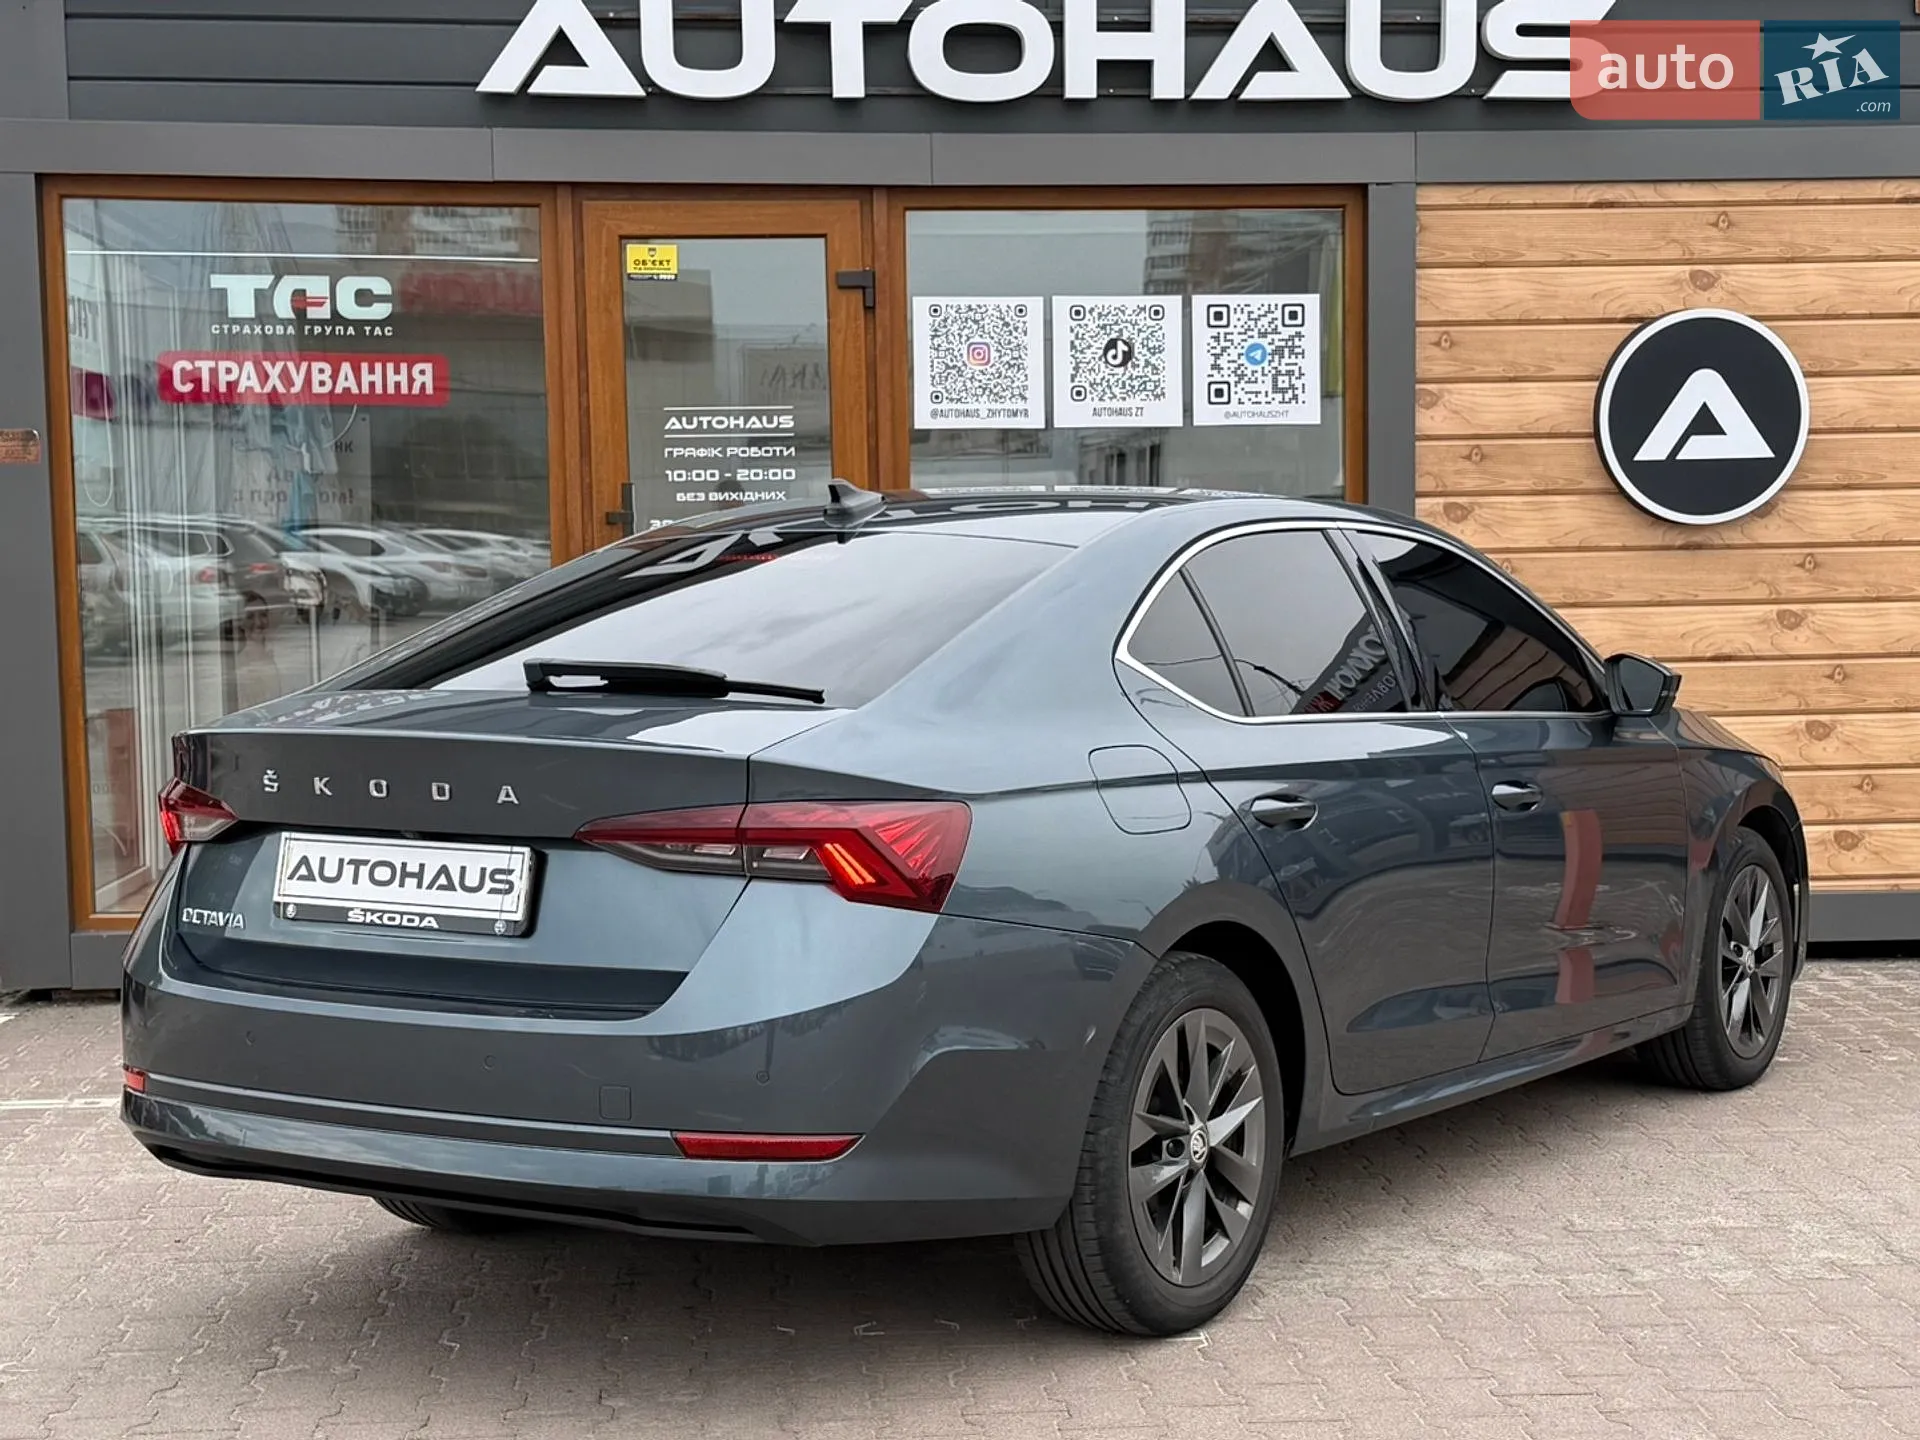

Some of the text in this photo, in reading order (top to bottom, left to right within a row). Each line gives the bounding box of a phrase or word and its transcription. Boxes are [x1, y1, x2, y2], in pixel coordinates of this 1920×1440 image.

[476, 0, 1613, 104] AUTOHAUS
[211, 324, 394, 336] СТРАХОВА ГРУПА ТАС
[172, 360, 434, 395] СТРАХУВАННЯ
[930, 407, 1030, 420] @AUTOHAUS_ZHYTOMYR
[1092, 406, 1144, 417] AUTOHAUS ZT
[664, 415, 795, 430] AUTOHAUS
[664, 446, 796, 458] ГРАФІК РОБОТИ
[665, 469, 720, 482] 10:00
[736, 468, 796, 481] 20:00
[676, 491, 787, 502] БЕЗ ВИХІДНИХ
[262, 769, 519, 805] ŠKODA
[287, 854, 516, 896] AUTOHAUS
[181, 907, 246, 930] OCTAVIA
[346, 908, 439, 930] ŠKODA
